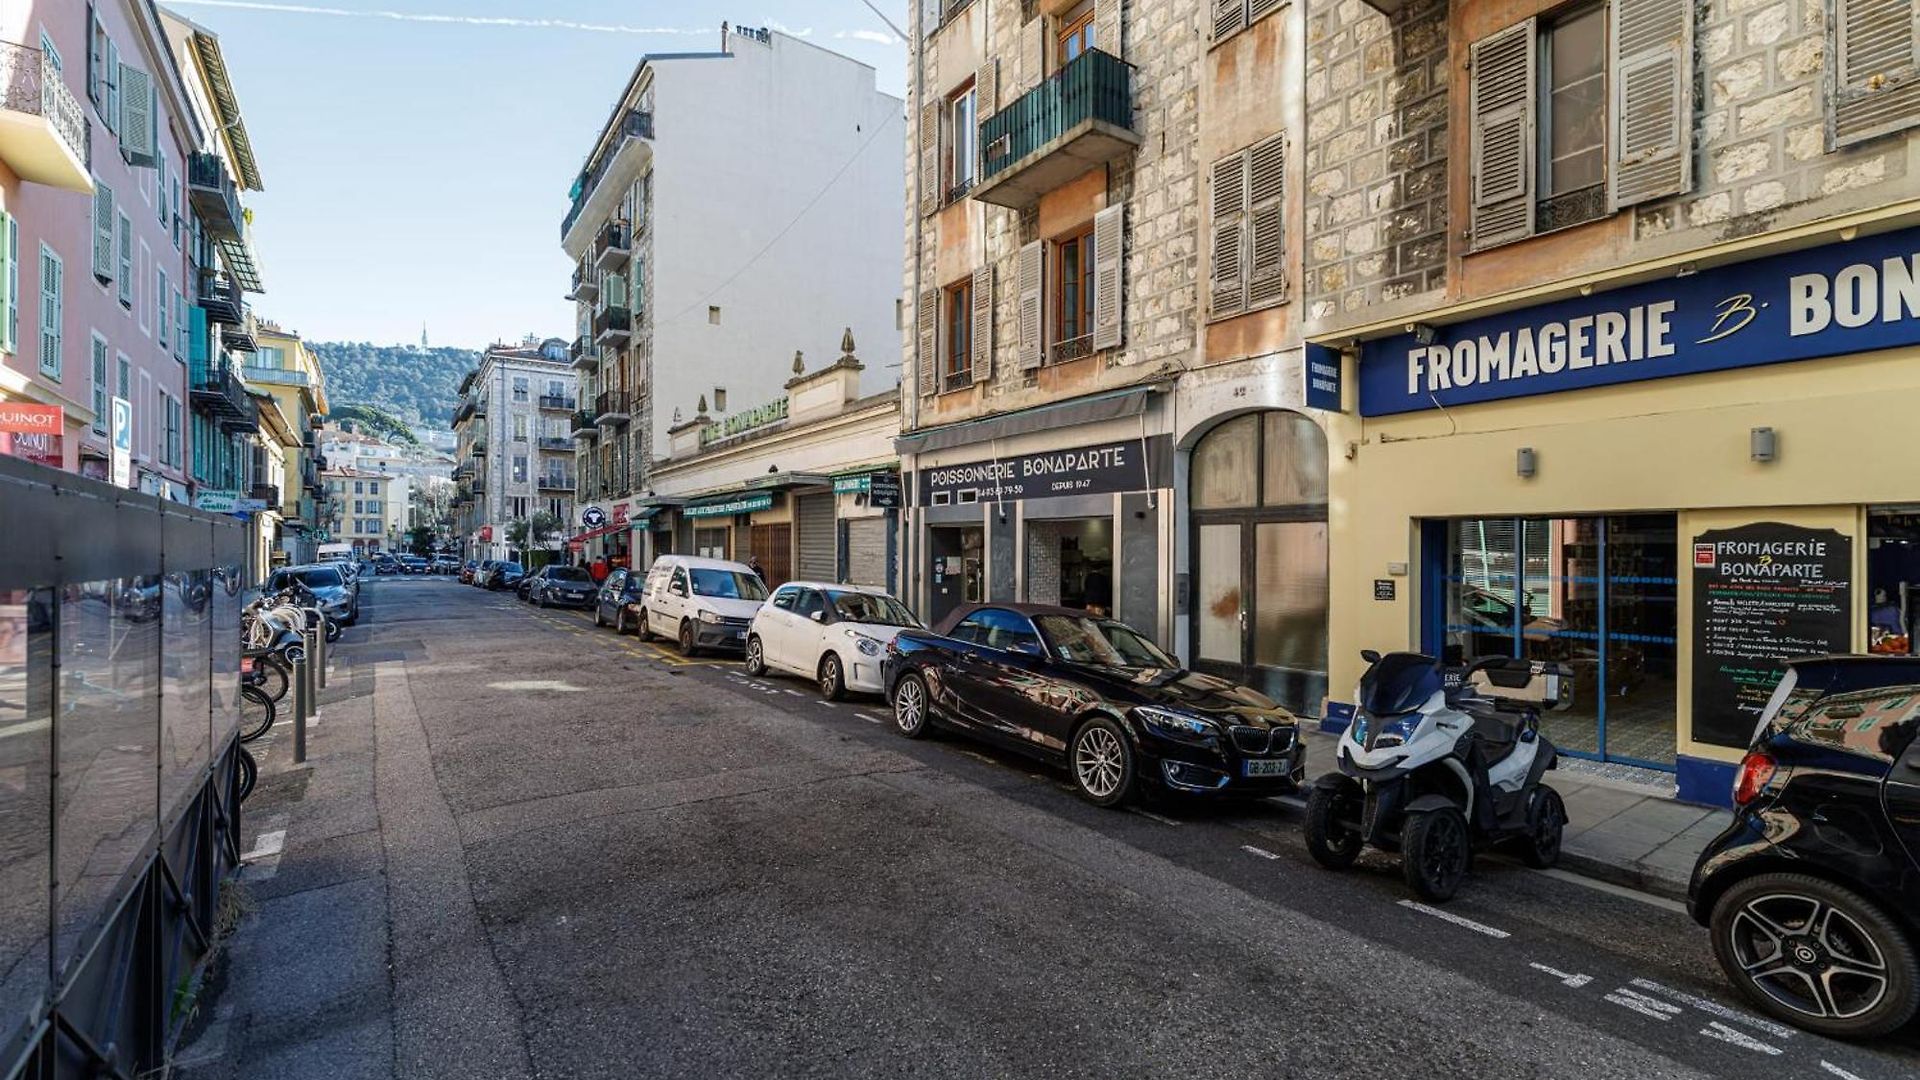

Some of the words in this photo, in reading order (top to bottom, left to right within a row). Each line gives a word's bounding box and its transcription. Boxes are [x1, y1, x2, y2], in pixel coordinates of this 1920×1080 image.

[1407, 300, 1676, 395] FROMAGERIE
[0, 412, 55, 425] UINOT
[931, 461, 1015, 487] POISSONNERIE
[1023, 446, 1125, 476] BONAPARTE
[1052, 481, 1073, 491] DEPUIS
[1721, 562, 1824, 578] BONAPARTE
